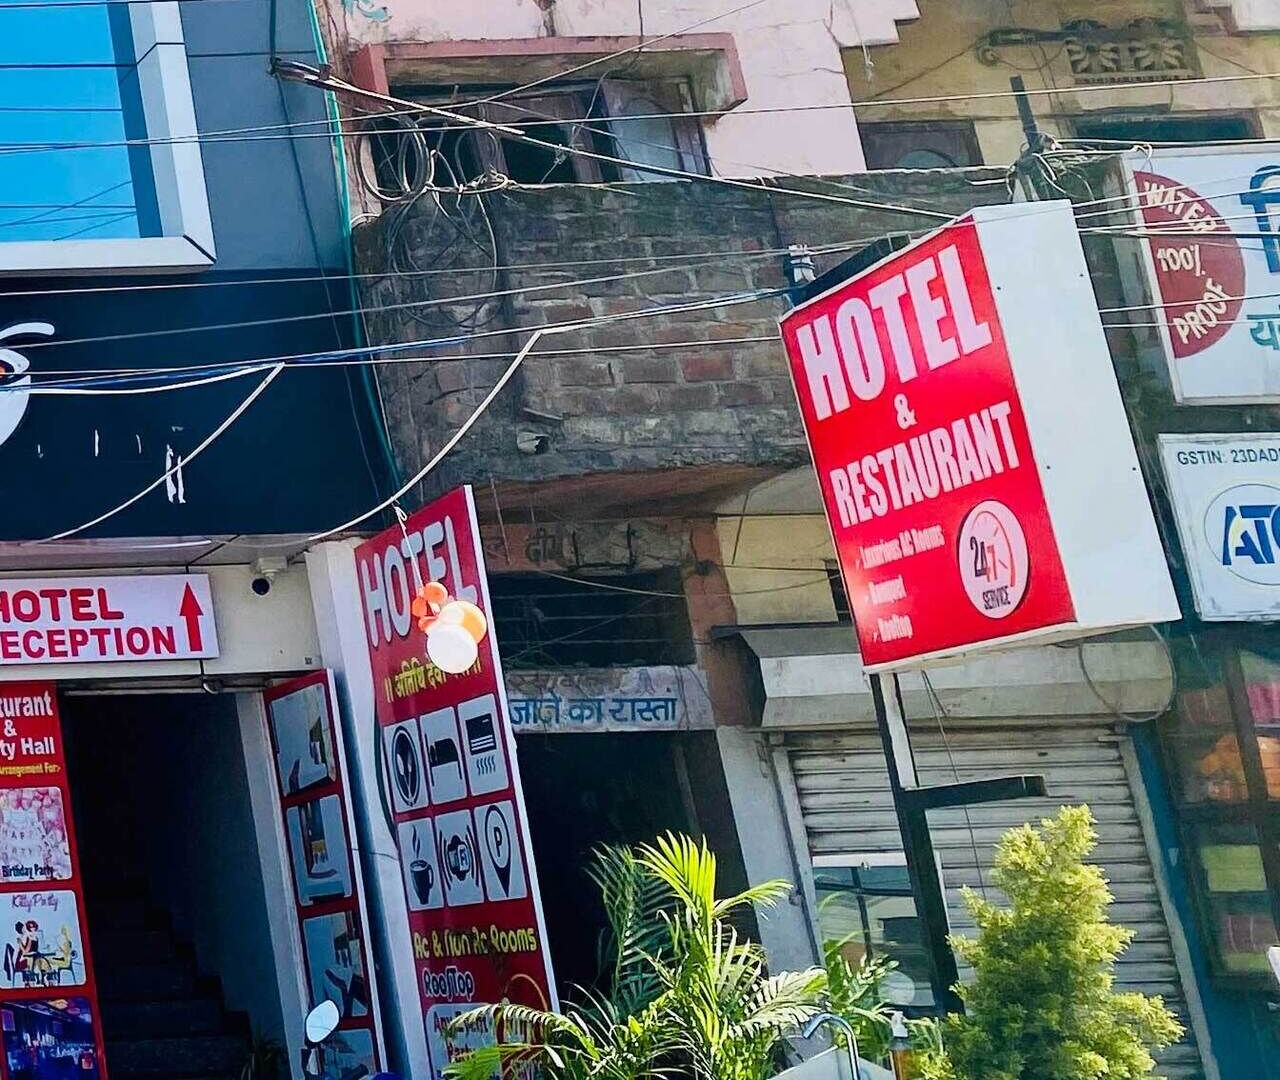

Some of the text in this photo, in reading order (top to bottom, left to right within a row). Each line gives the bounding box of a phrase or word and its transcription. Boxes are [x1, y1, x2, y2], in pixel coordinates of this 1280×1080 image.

[796, 244, 993, 422] HOTEL
[895, 393, 917, 429] &
[829, 401, 1021, 528] RESTAURANT
[1177, 448, 1280, 465] GSTIN: 23DAD
[568, 697, 605, 723] का
[609, 697, 678, 722] रास्ता
[4, 719, 17, 737] &
[21, 737, 55, 755] Hall
[490, 924, 537, 952] Rooms
